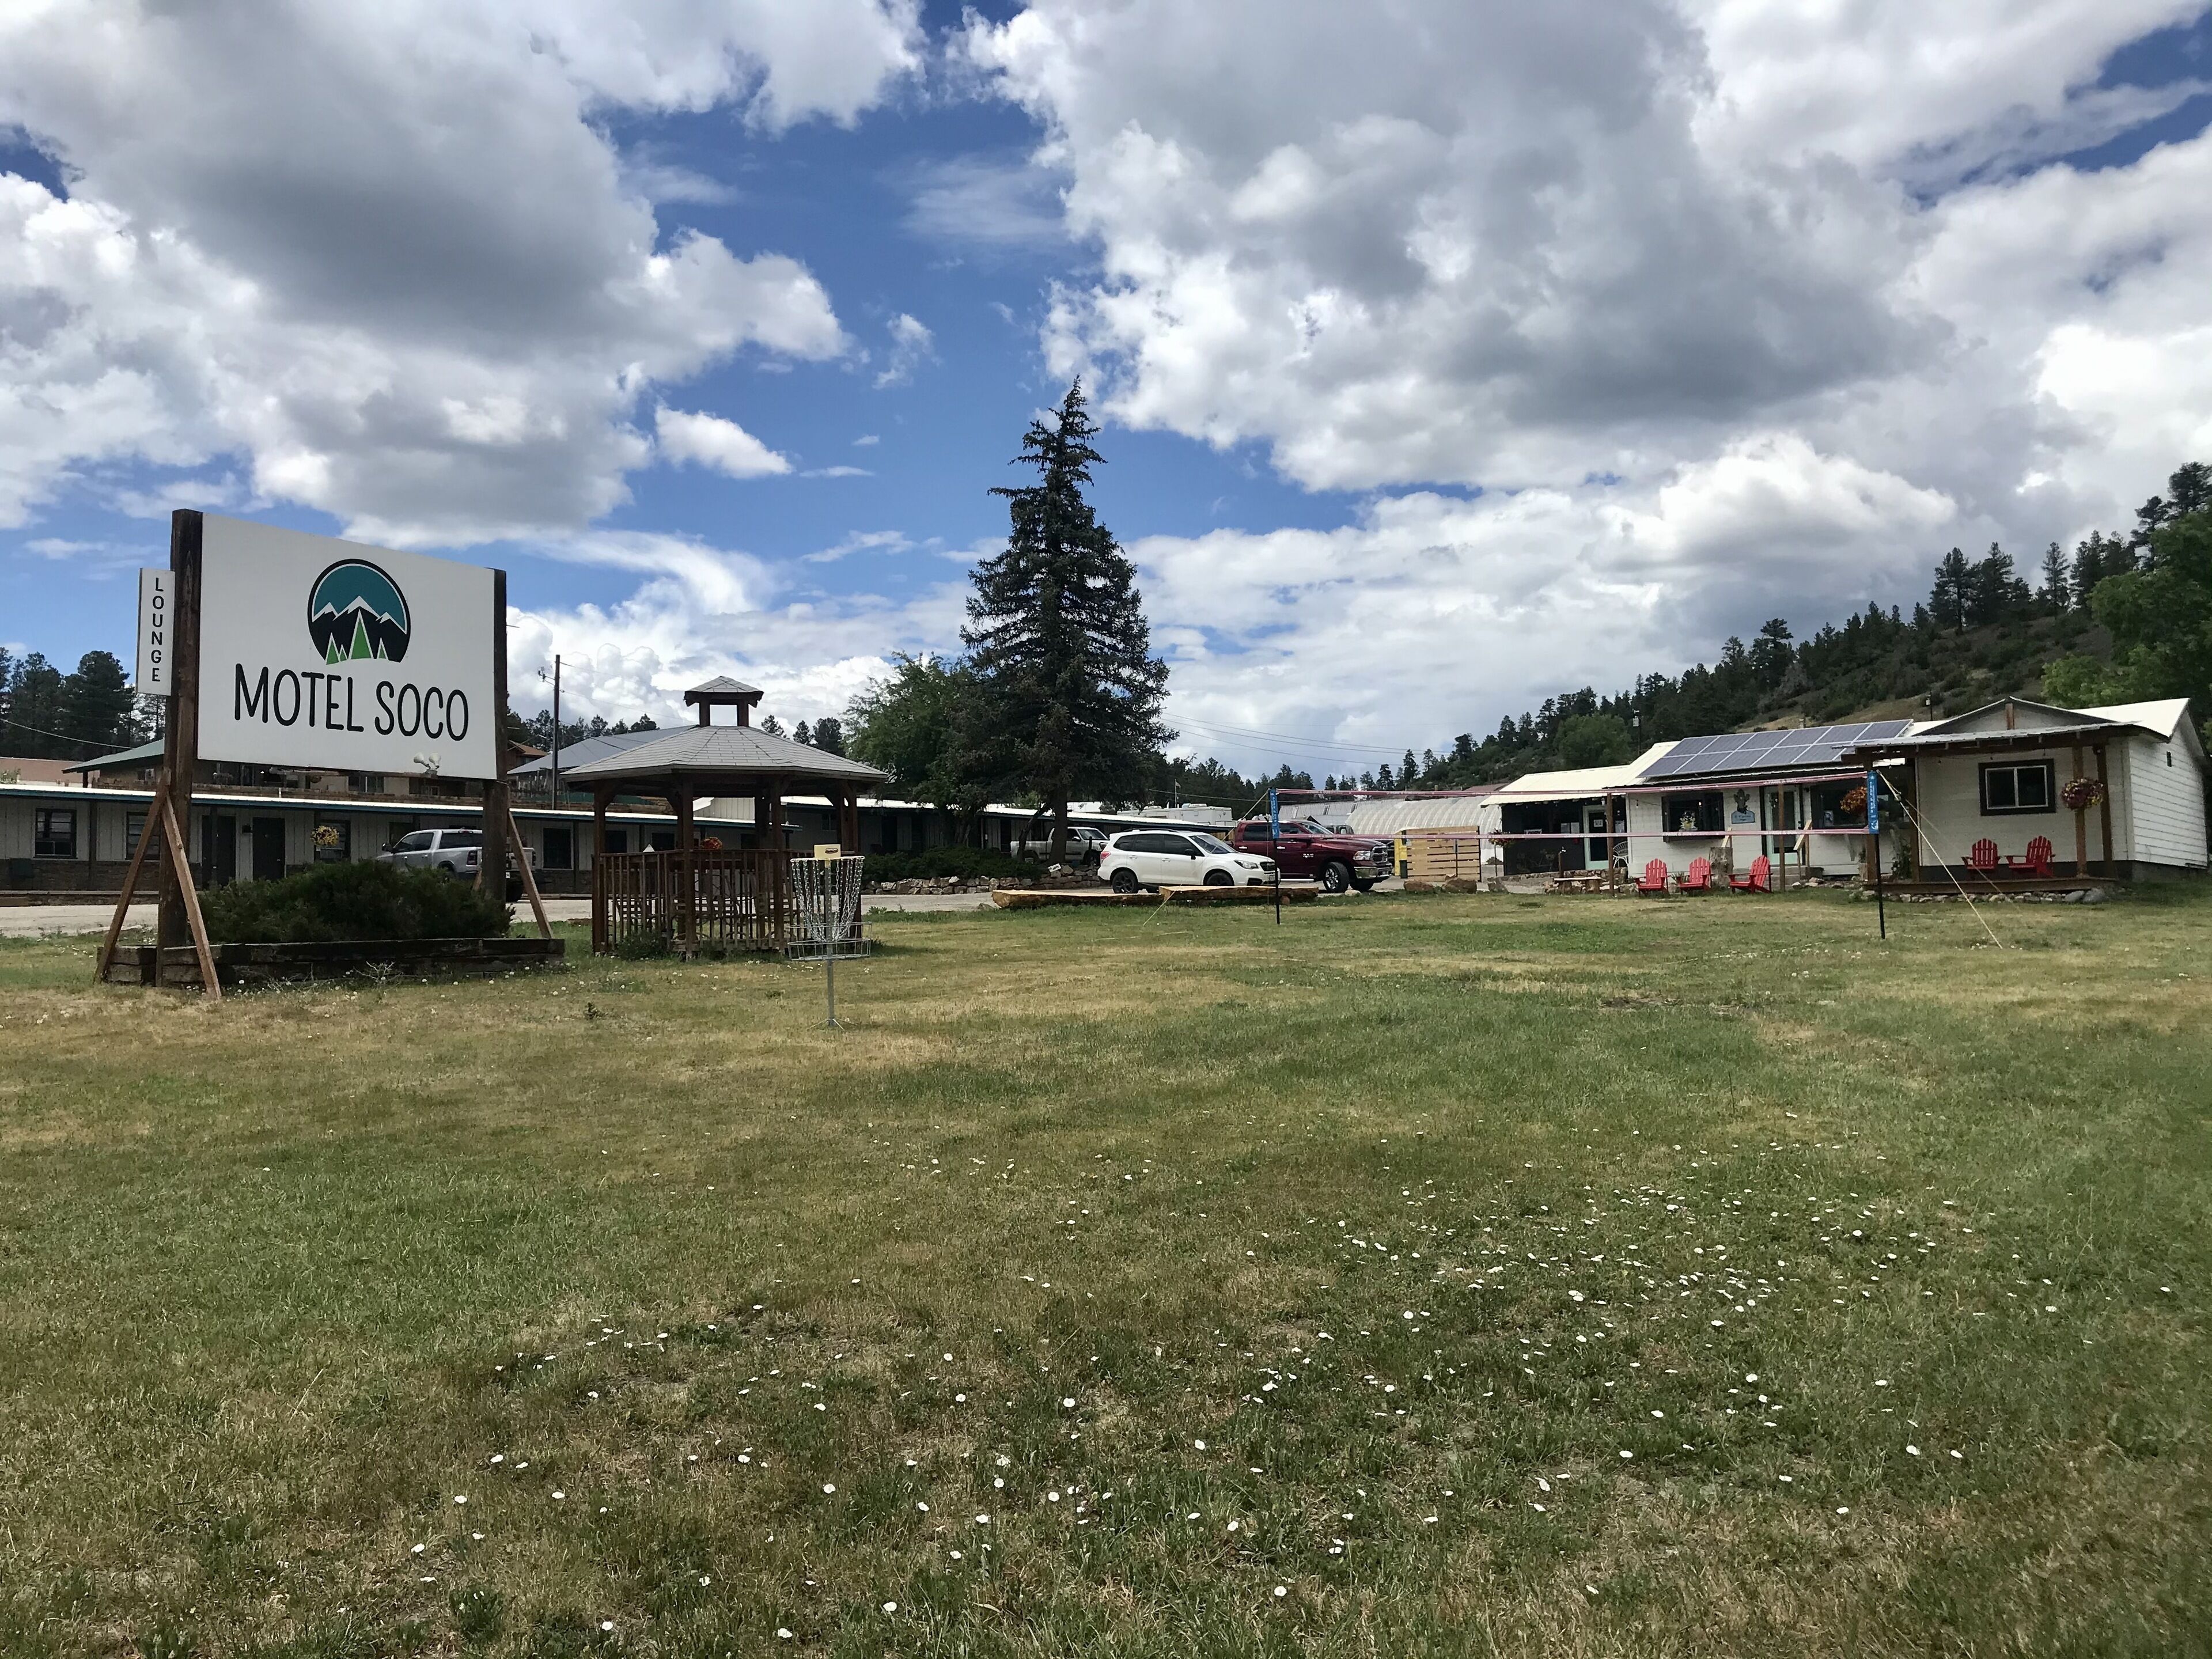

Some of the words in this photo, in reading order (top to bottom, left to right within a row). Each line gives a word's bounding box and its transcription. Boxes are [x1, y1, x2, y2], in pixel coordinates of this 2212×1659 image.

[151, 577, 165, 682] LOUNGE
[234, 663, 364, 732] MOTEL
[374, 680, 468, 741] SOCO
